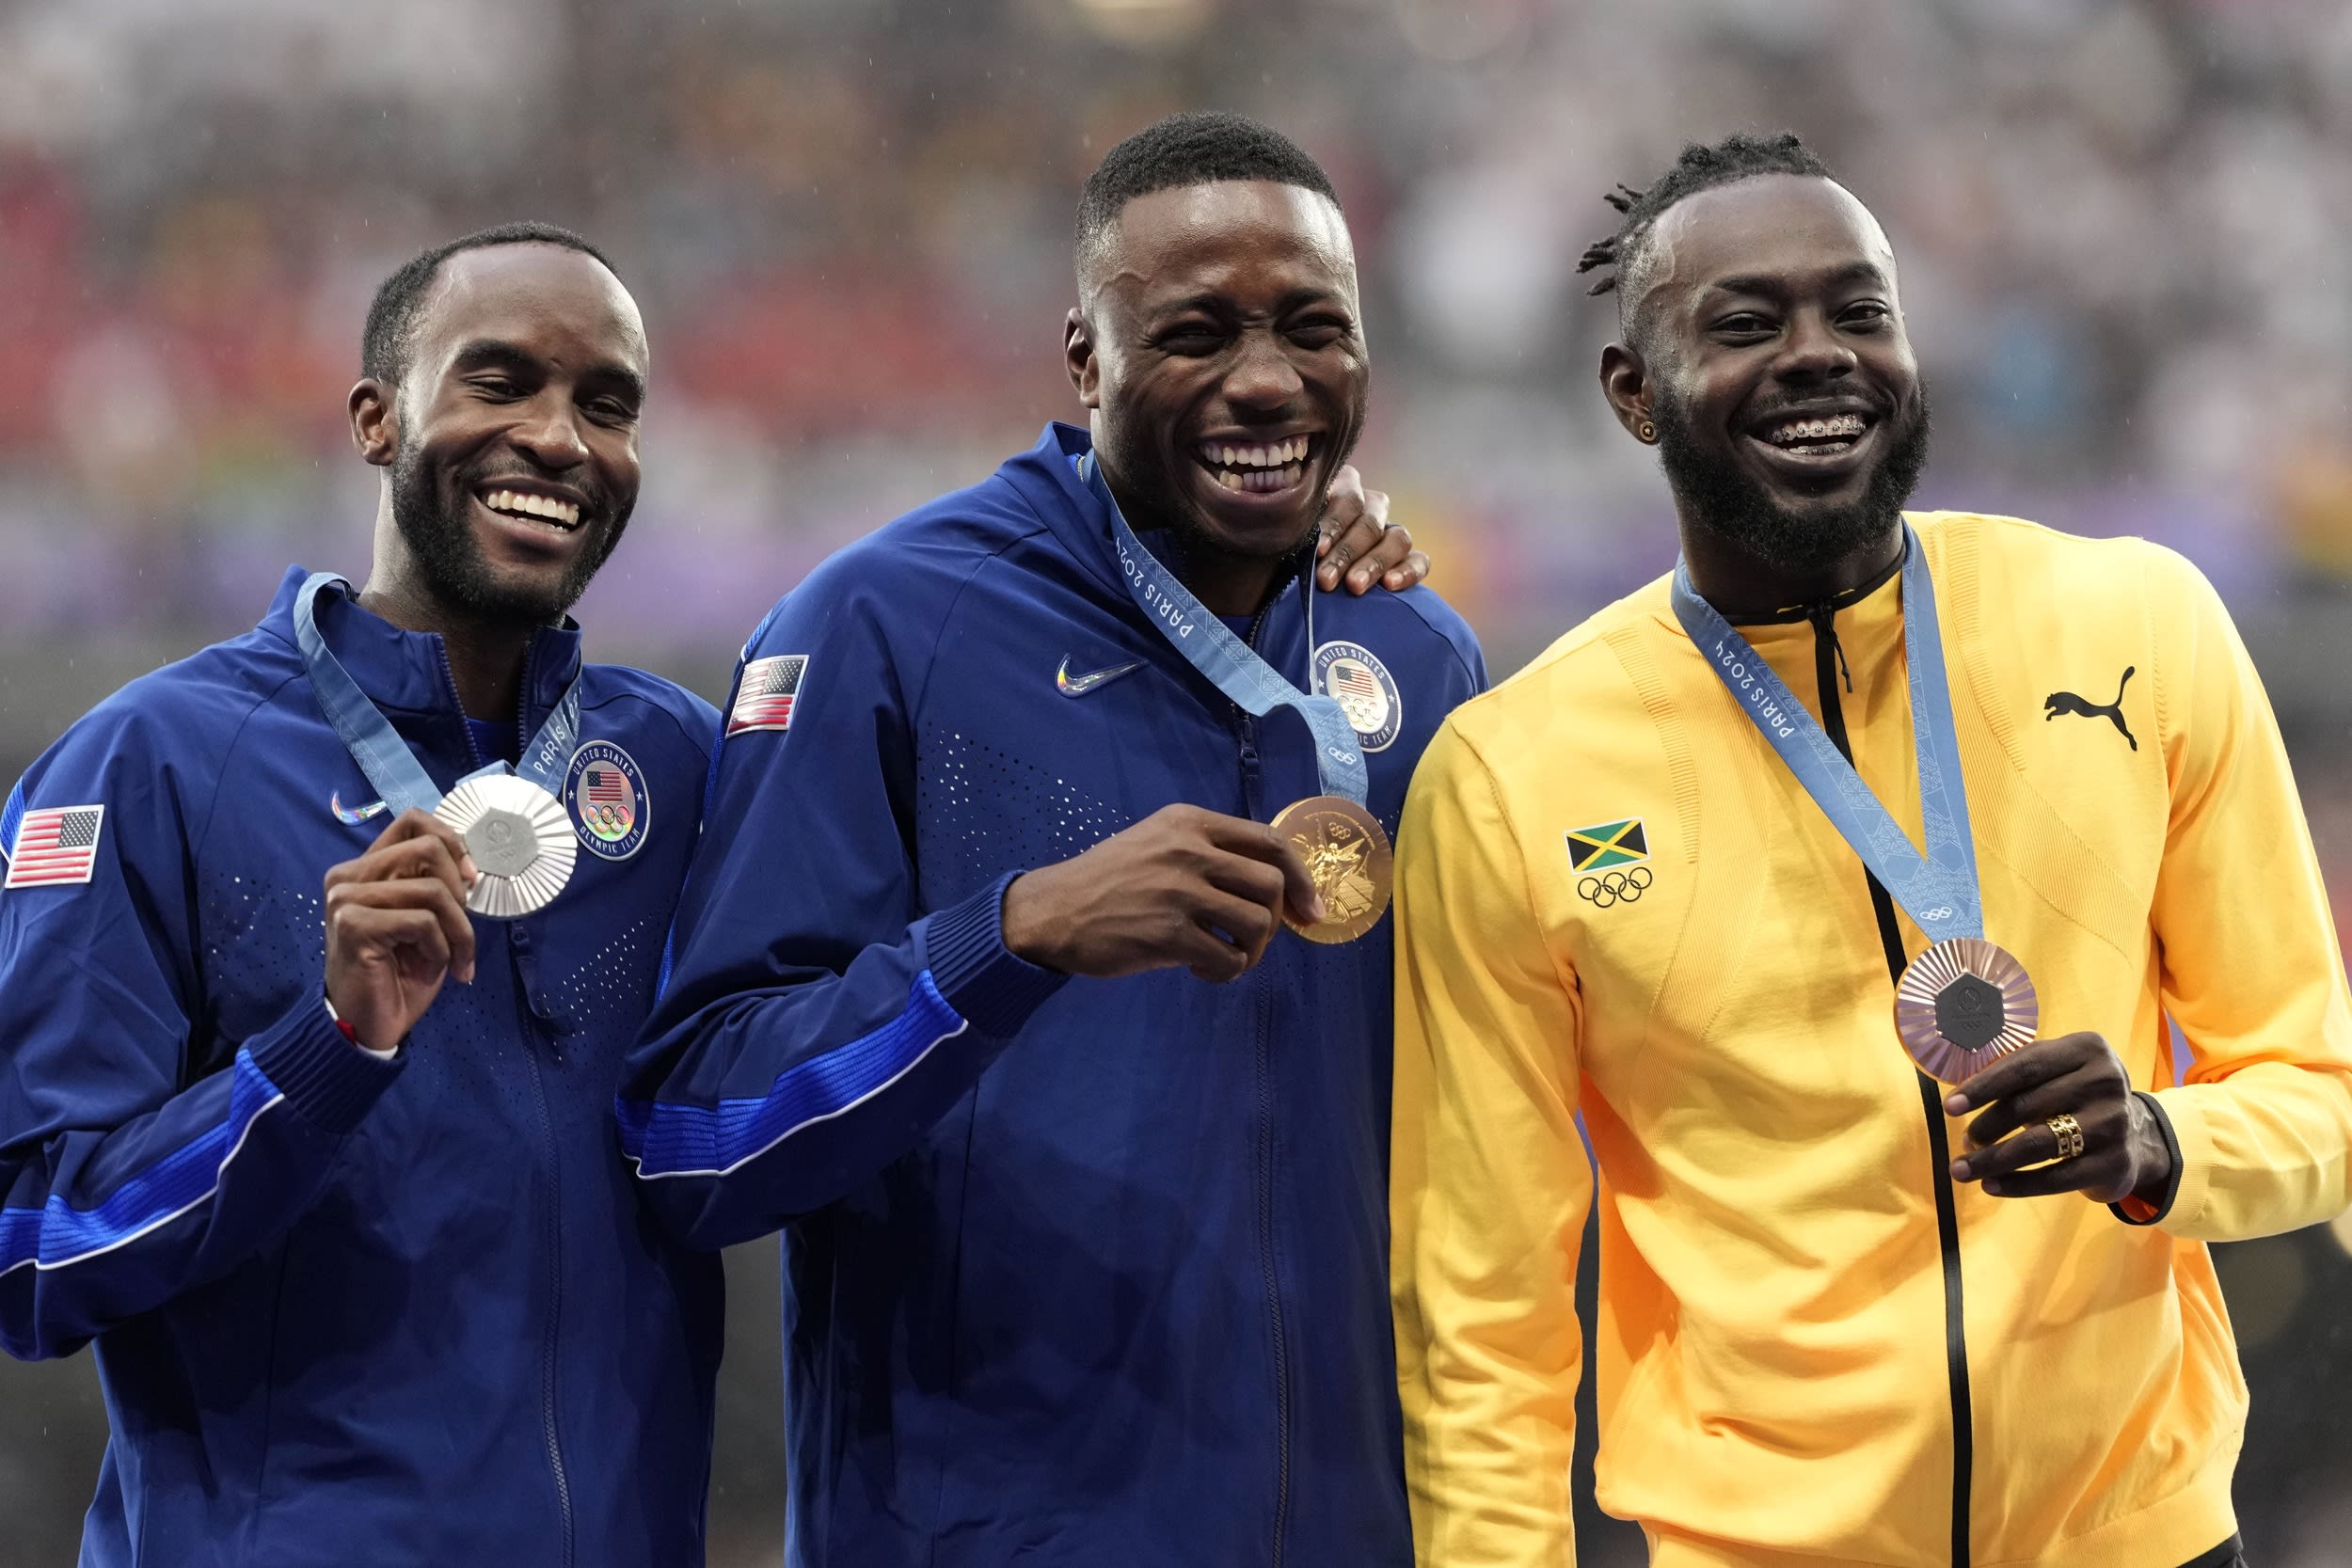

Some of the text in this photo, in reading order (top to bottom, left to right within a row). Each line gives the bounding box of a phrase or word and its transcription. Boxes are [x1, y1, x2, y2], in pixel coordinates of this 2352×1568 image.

[1116, 536, 1145, 588] 2024
[1318, 646, 1385, 679] UNITED STATES
[1715, 641, 1756, 689] 2024
[1372, 725, 1392, 746] TEAM
[572, 746, 635, 778] UNITED STATES
[580, 824, 641, 854] OLYMPIC TEAM
